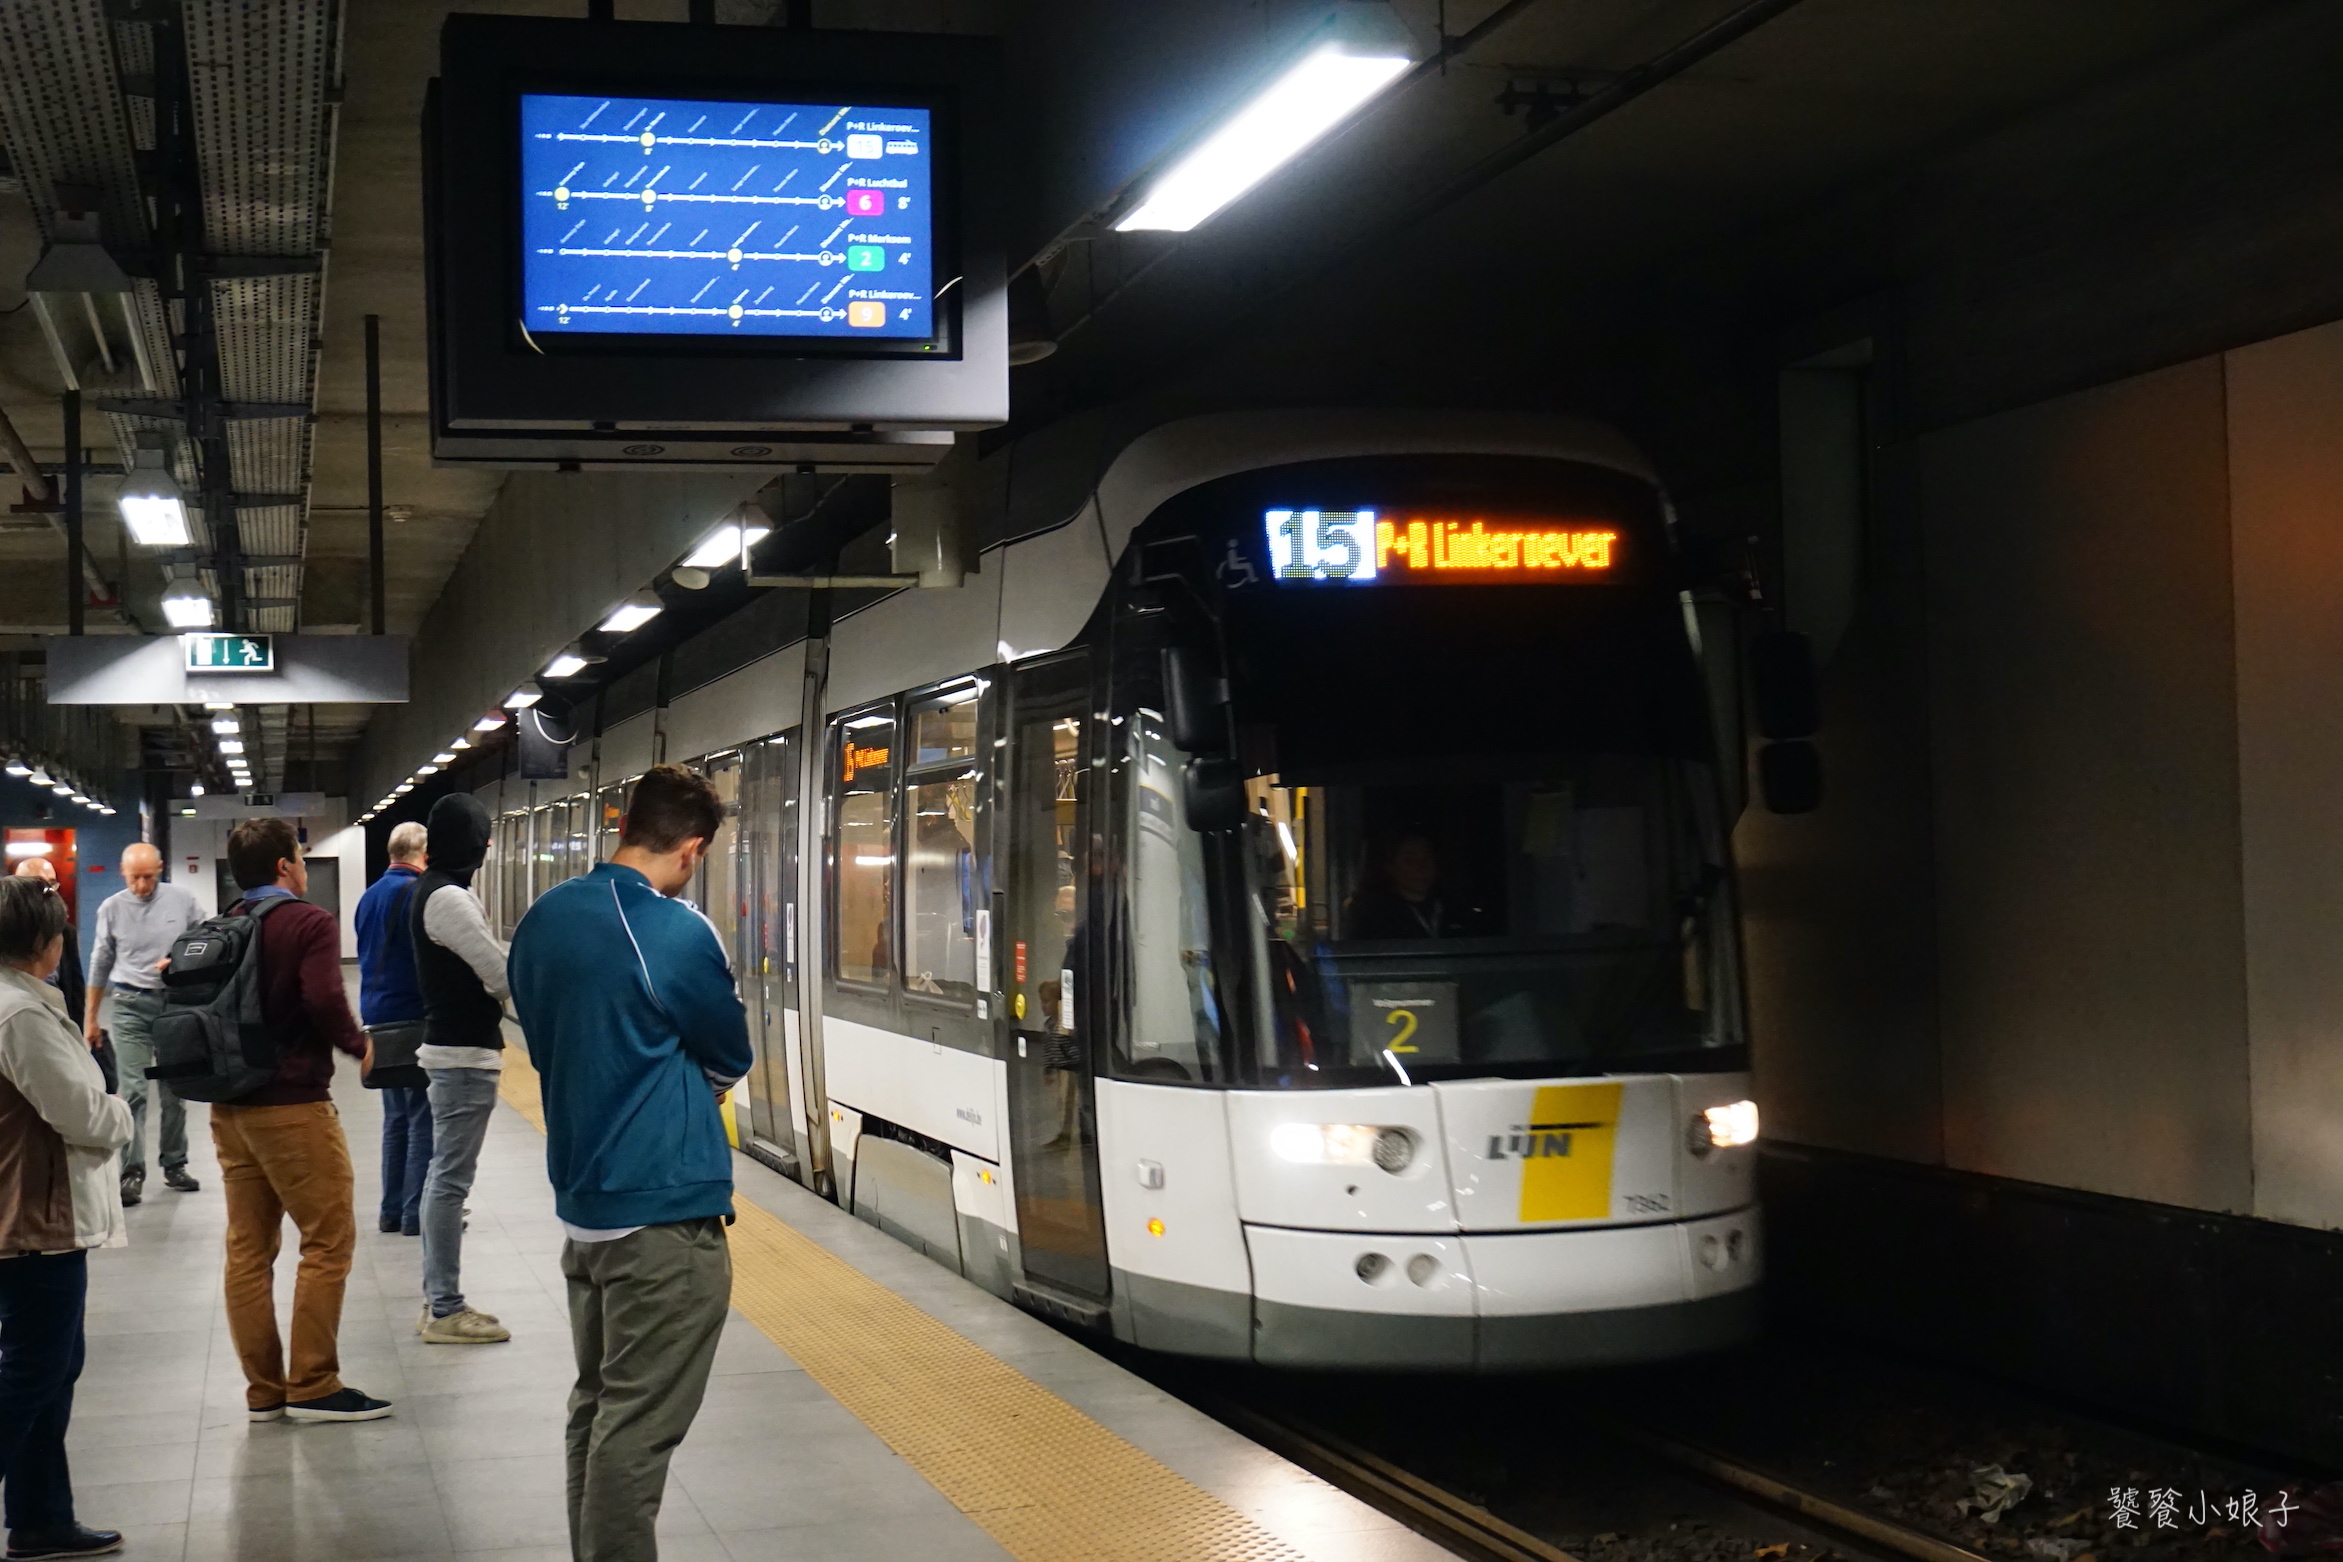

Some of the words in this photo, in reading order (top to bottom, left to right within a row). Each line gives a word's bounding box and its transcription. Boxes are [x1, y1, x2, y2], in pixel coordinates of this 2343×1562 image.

[857, 140, 873, 153] 15
[859, 194, 872, 210] 6
[860, 251, 872, 266] 2
[861, 307, 873, 322] 9
[1279, 510, 1363, 579] 15
[1385, 1009, 1420, 1053] 2
